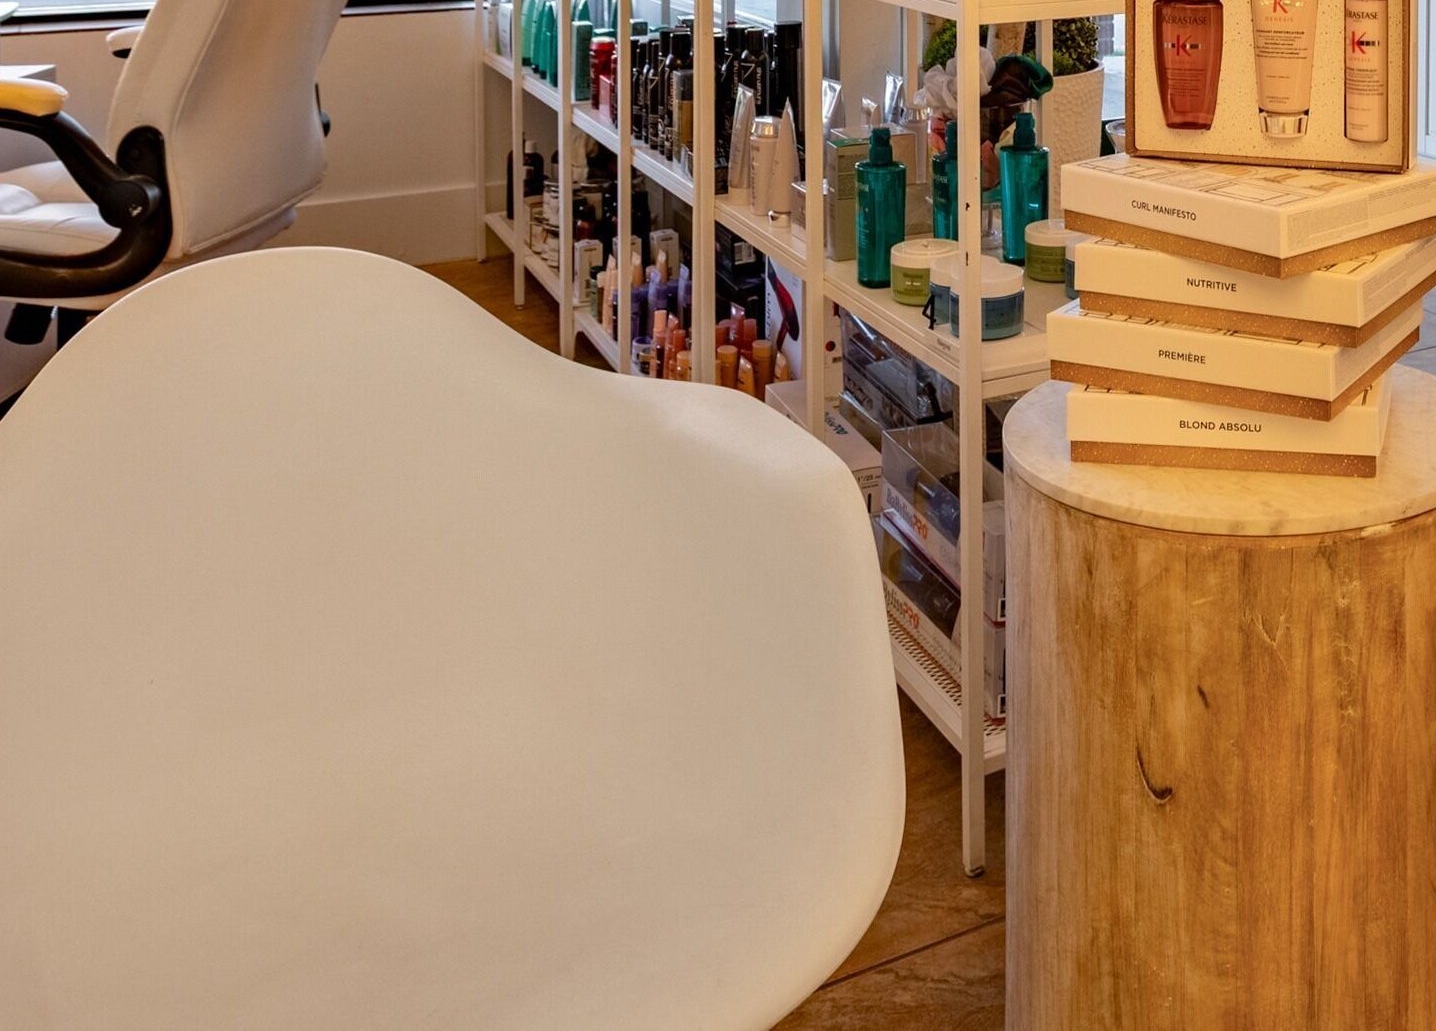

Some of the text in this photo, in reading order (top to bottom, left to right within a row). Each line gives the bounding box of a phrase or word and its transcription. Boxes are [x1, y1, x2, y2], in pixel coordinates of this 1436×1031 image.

[1131, 200, 1197, 222] CURL MANIFESTO
[1187, 277, 1237, 292] NUTRITIVE
[1158, 349, 1206, 365] PREMIÈRE
[1179, 420, 1262, 433] BLOND ABSOLU
